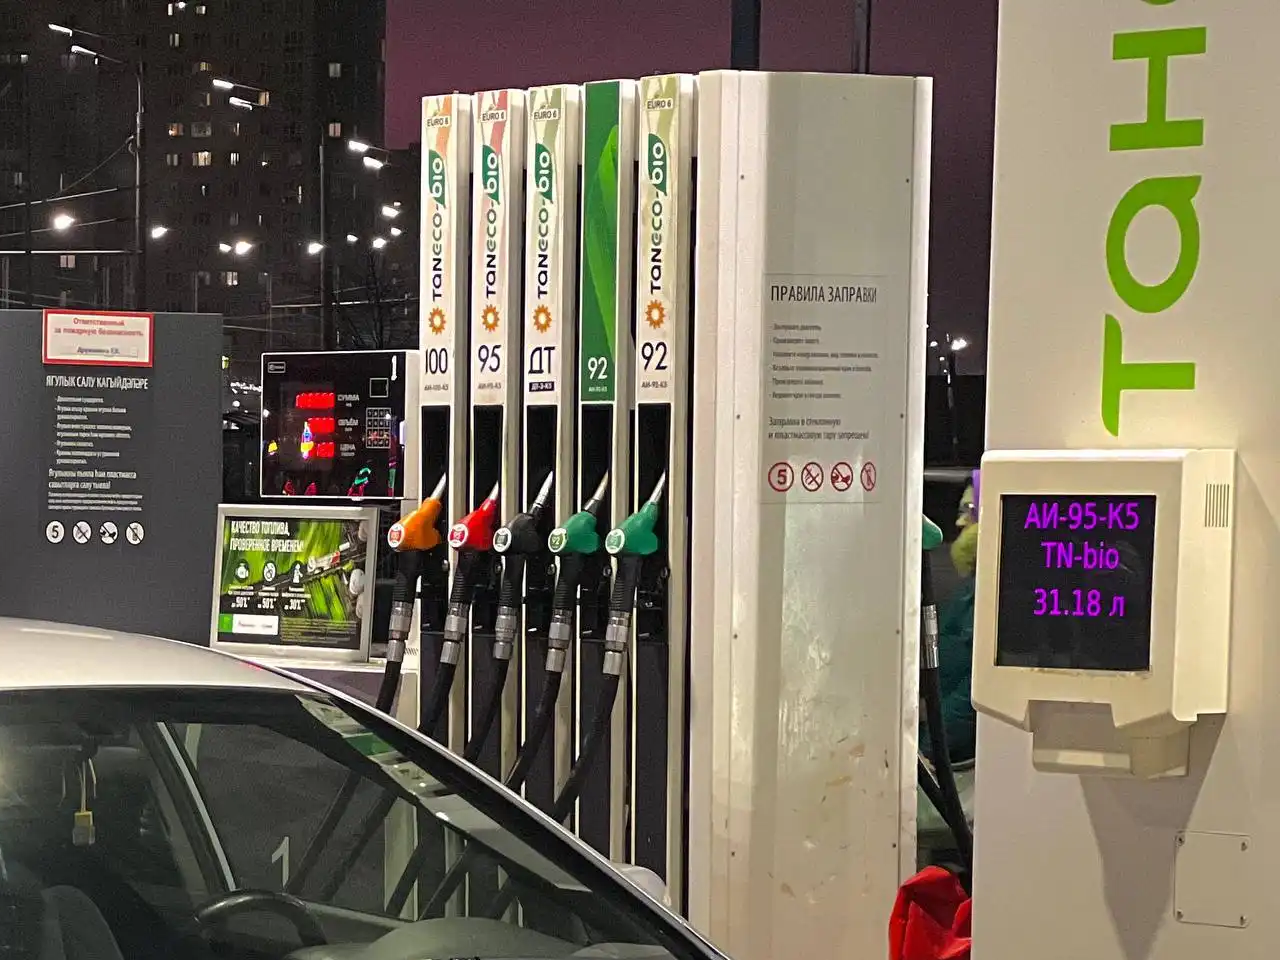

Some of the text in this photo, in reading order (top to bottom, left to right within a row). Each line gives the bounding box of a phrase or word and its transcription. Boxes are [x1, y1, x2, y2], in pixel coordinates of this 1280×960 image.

[646, 100, 665, 109] EURO
[426, 117, 443, 126] EURO
[482, 112, 498, 121] EURO
[533, 111, 551, 120] EURO
[771, 285, 877, 303] ПРАВИЛА ЗАПРАВКИ
[425, 347, 449, 375] 100
[478, 344, 502, 373] 95
[528, 346, 556, 374] ДТ
[641, 341, 668, 371] 92
[588, 356, 608, 381] 92
[46, 375, 75, 387] ЯГУЛЫК
[77, 376, 95, 388] САЛУ
[1024, 502, 1140, 530] АИ-95-К5
[51, 525, 59, 539] 5
[231, 520, 260, 534] КАЧЕСТВО
[1041, 541, 1120, 569] TN-bio
[1033, 588, 1126, 617] 31.18 л
